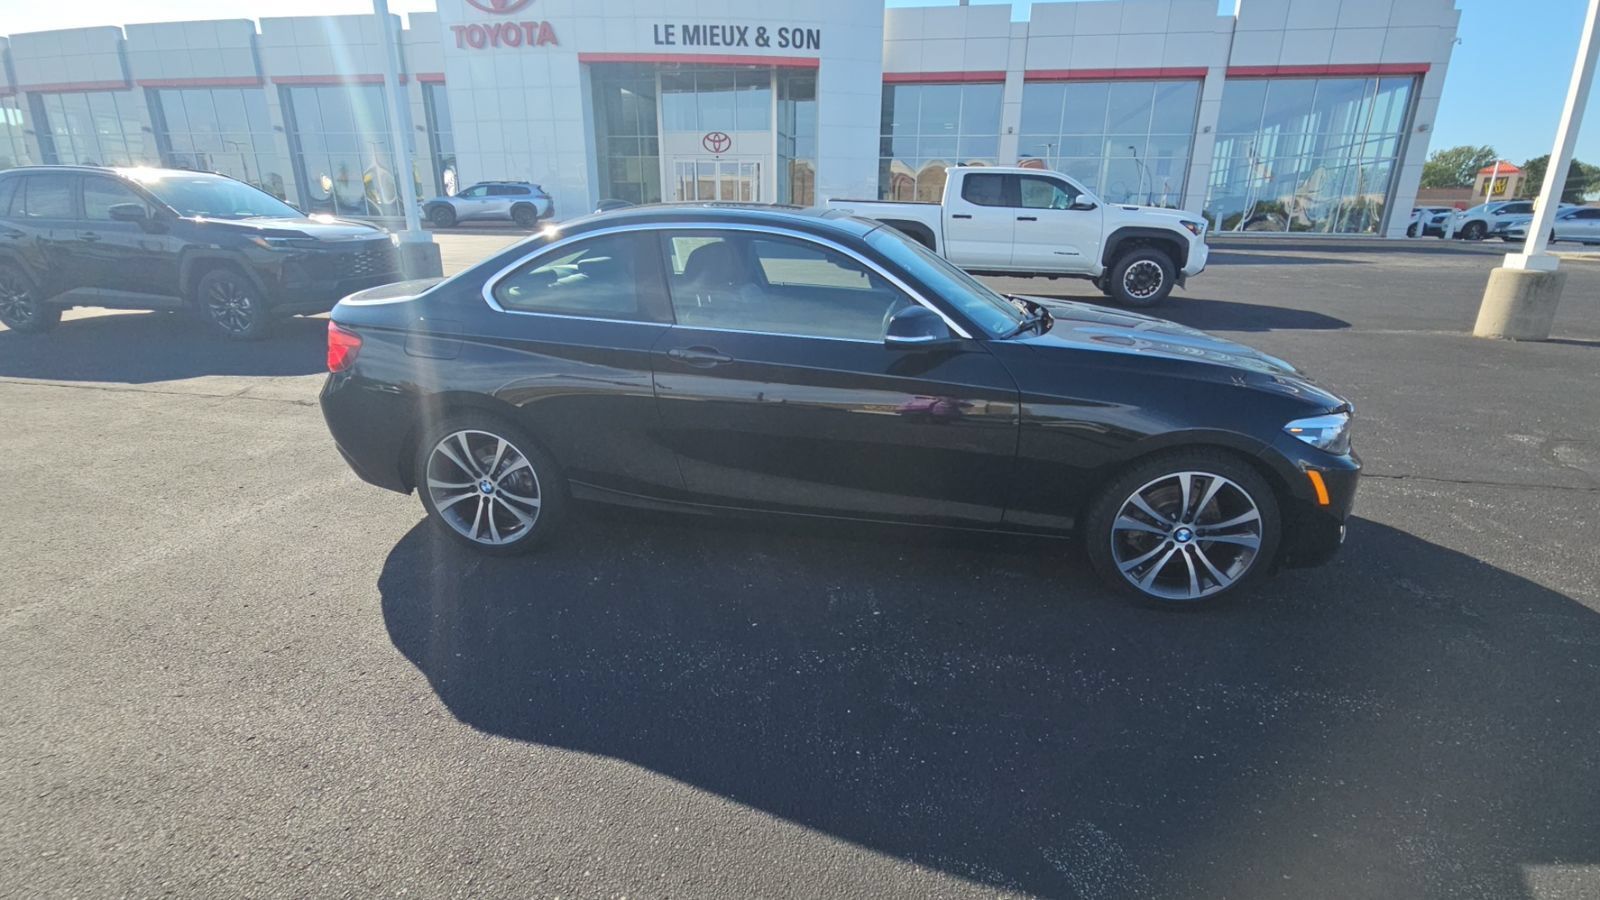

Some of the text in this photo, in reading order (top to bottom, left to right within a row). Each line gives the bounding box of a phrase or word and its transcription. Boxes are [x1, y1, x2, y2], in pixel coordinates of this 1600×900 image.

[449, 20, 559, 49] TOYOTA
[653, 24, 821, 50] LE MIEUX & SON
